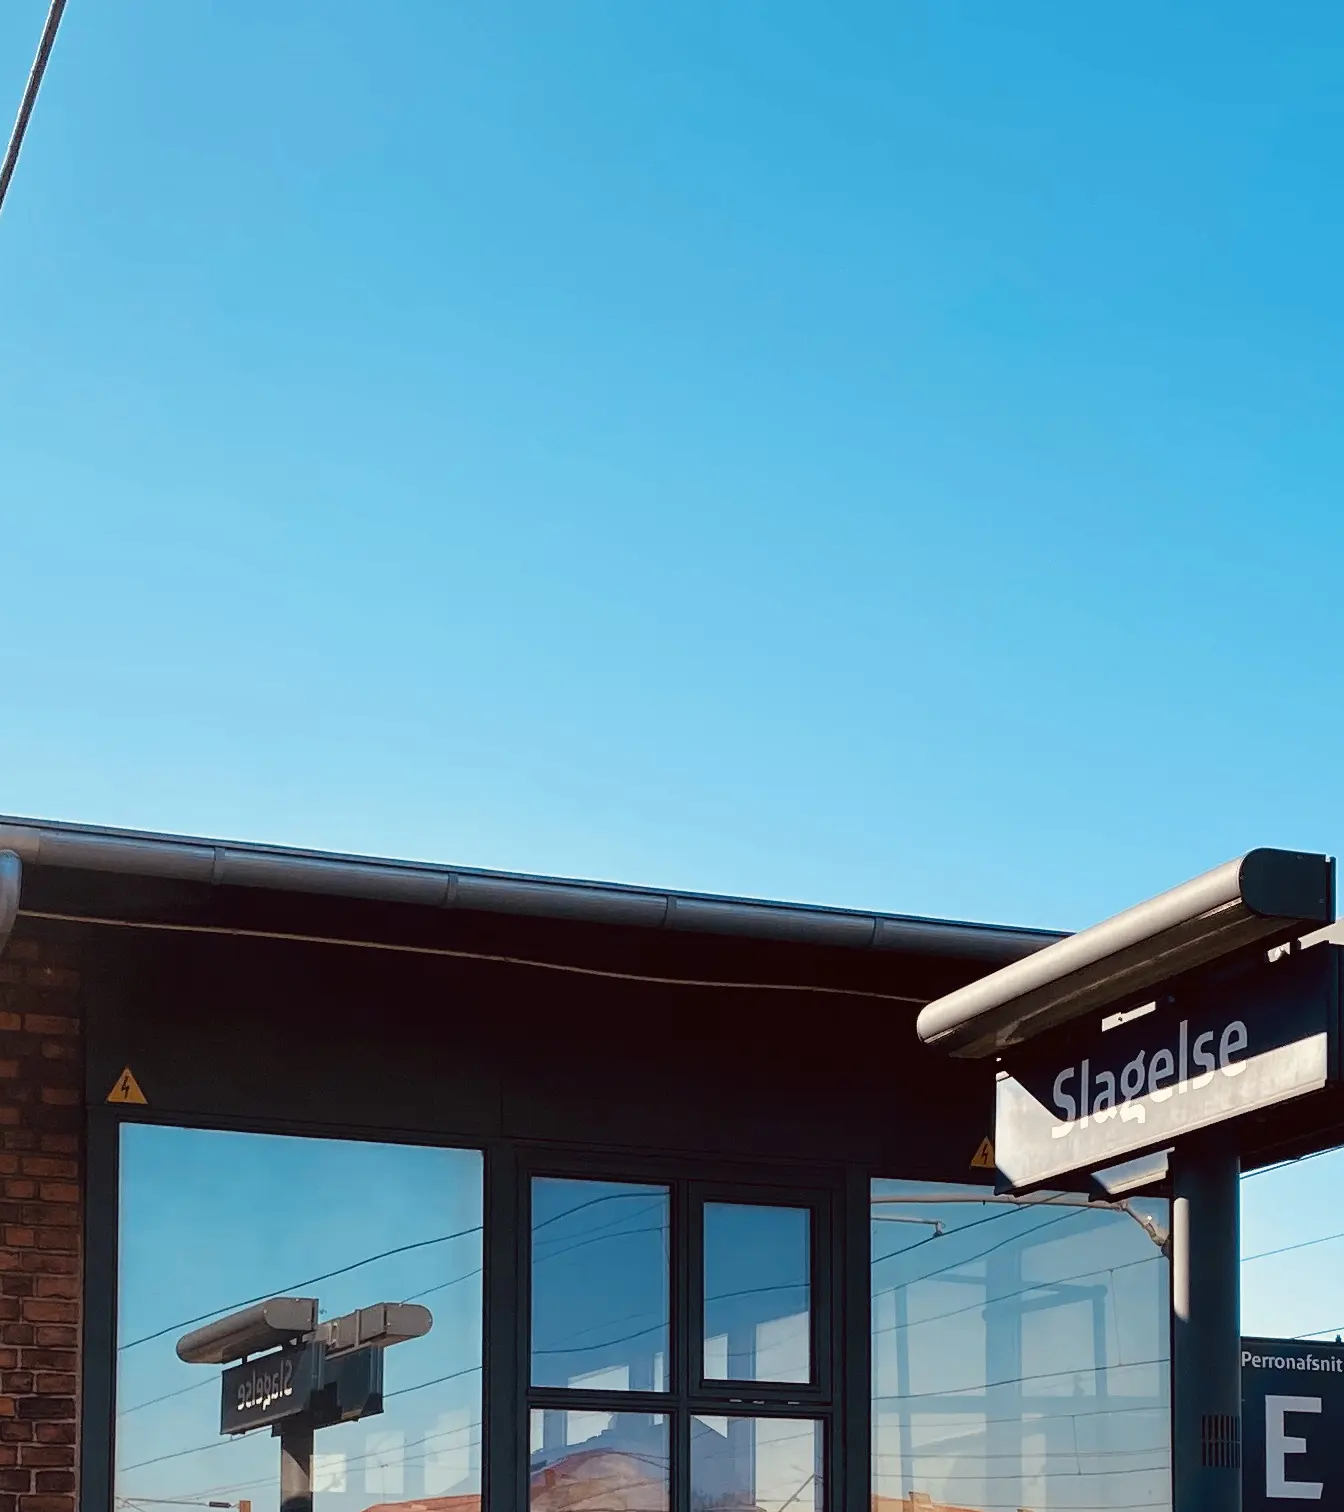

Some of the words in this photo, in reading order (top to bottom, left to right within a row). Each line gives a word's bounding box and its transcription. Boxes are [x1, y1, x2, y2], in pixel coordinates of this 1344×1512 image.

[1051, 1019, 1248, 1139] Slagelse
[1241, 1351, 1344, 1373] Perronafsnit
[1264, 1394, 1324, 1500] E
